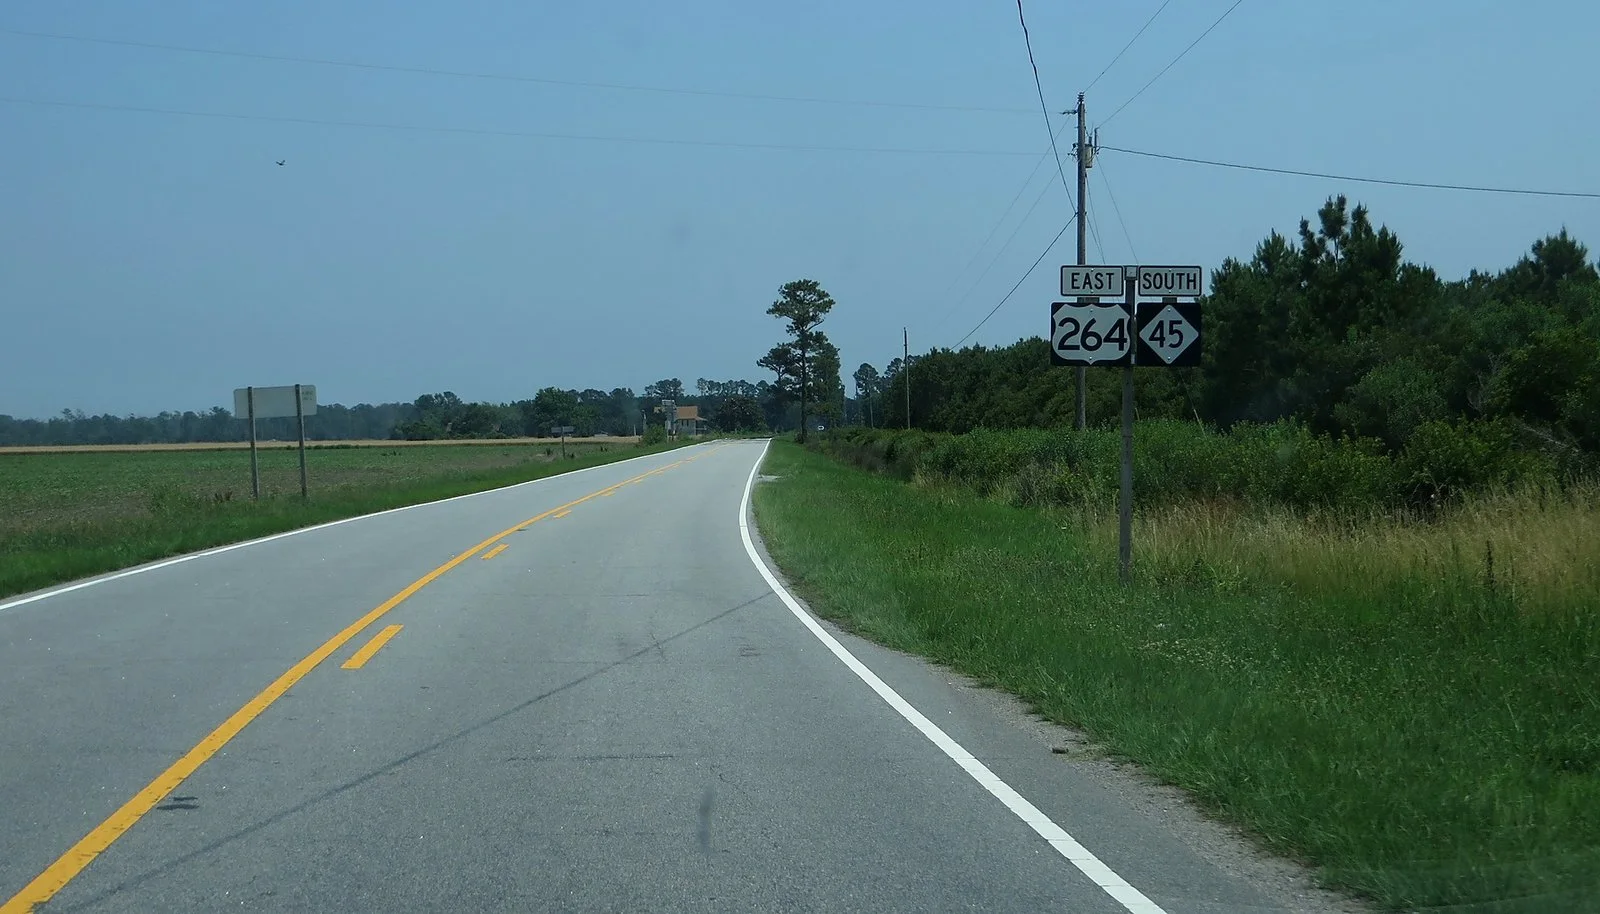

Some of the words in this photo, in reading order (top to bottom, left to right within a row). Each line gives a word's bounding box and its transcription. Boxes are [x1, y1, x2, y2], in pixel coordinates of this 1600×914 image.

[1071, 272, 1115, 290] EAST
[1142, 272, 1197, 290] SOUTH
[1058, 317, 1128, 351] 264
[1149, 320, 1184, 348] 45
